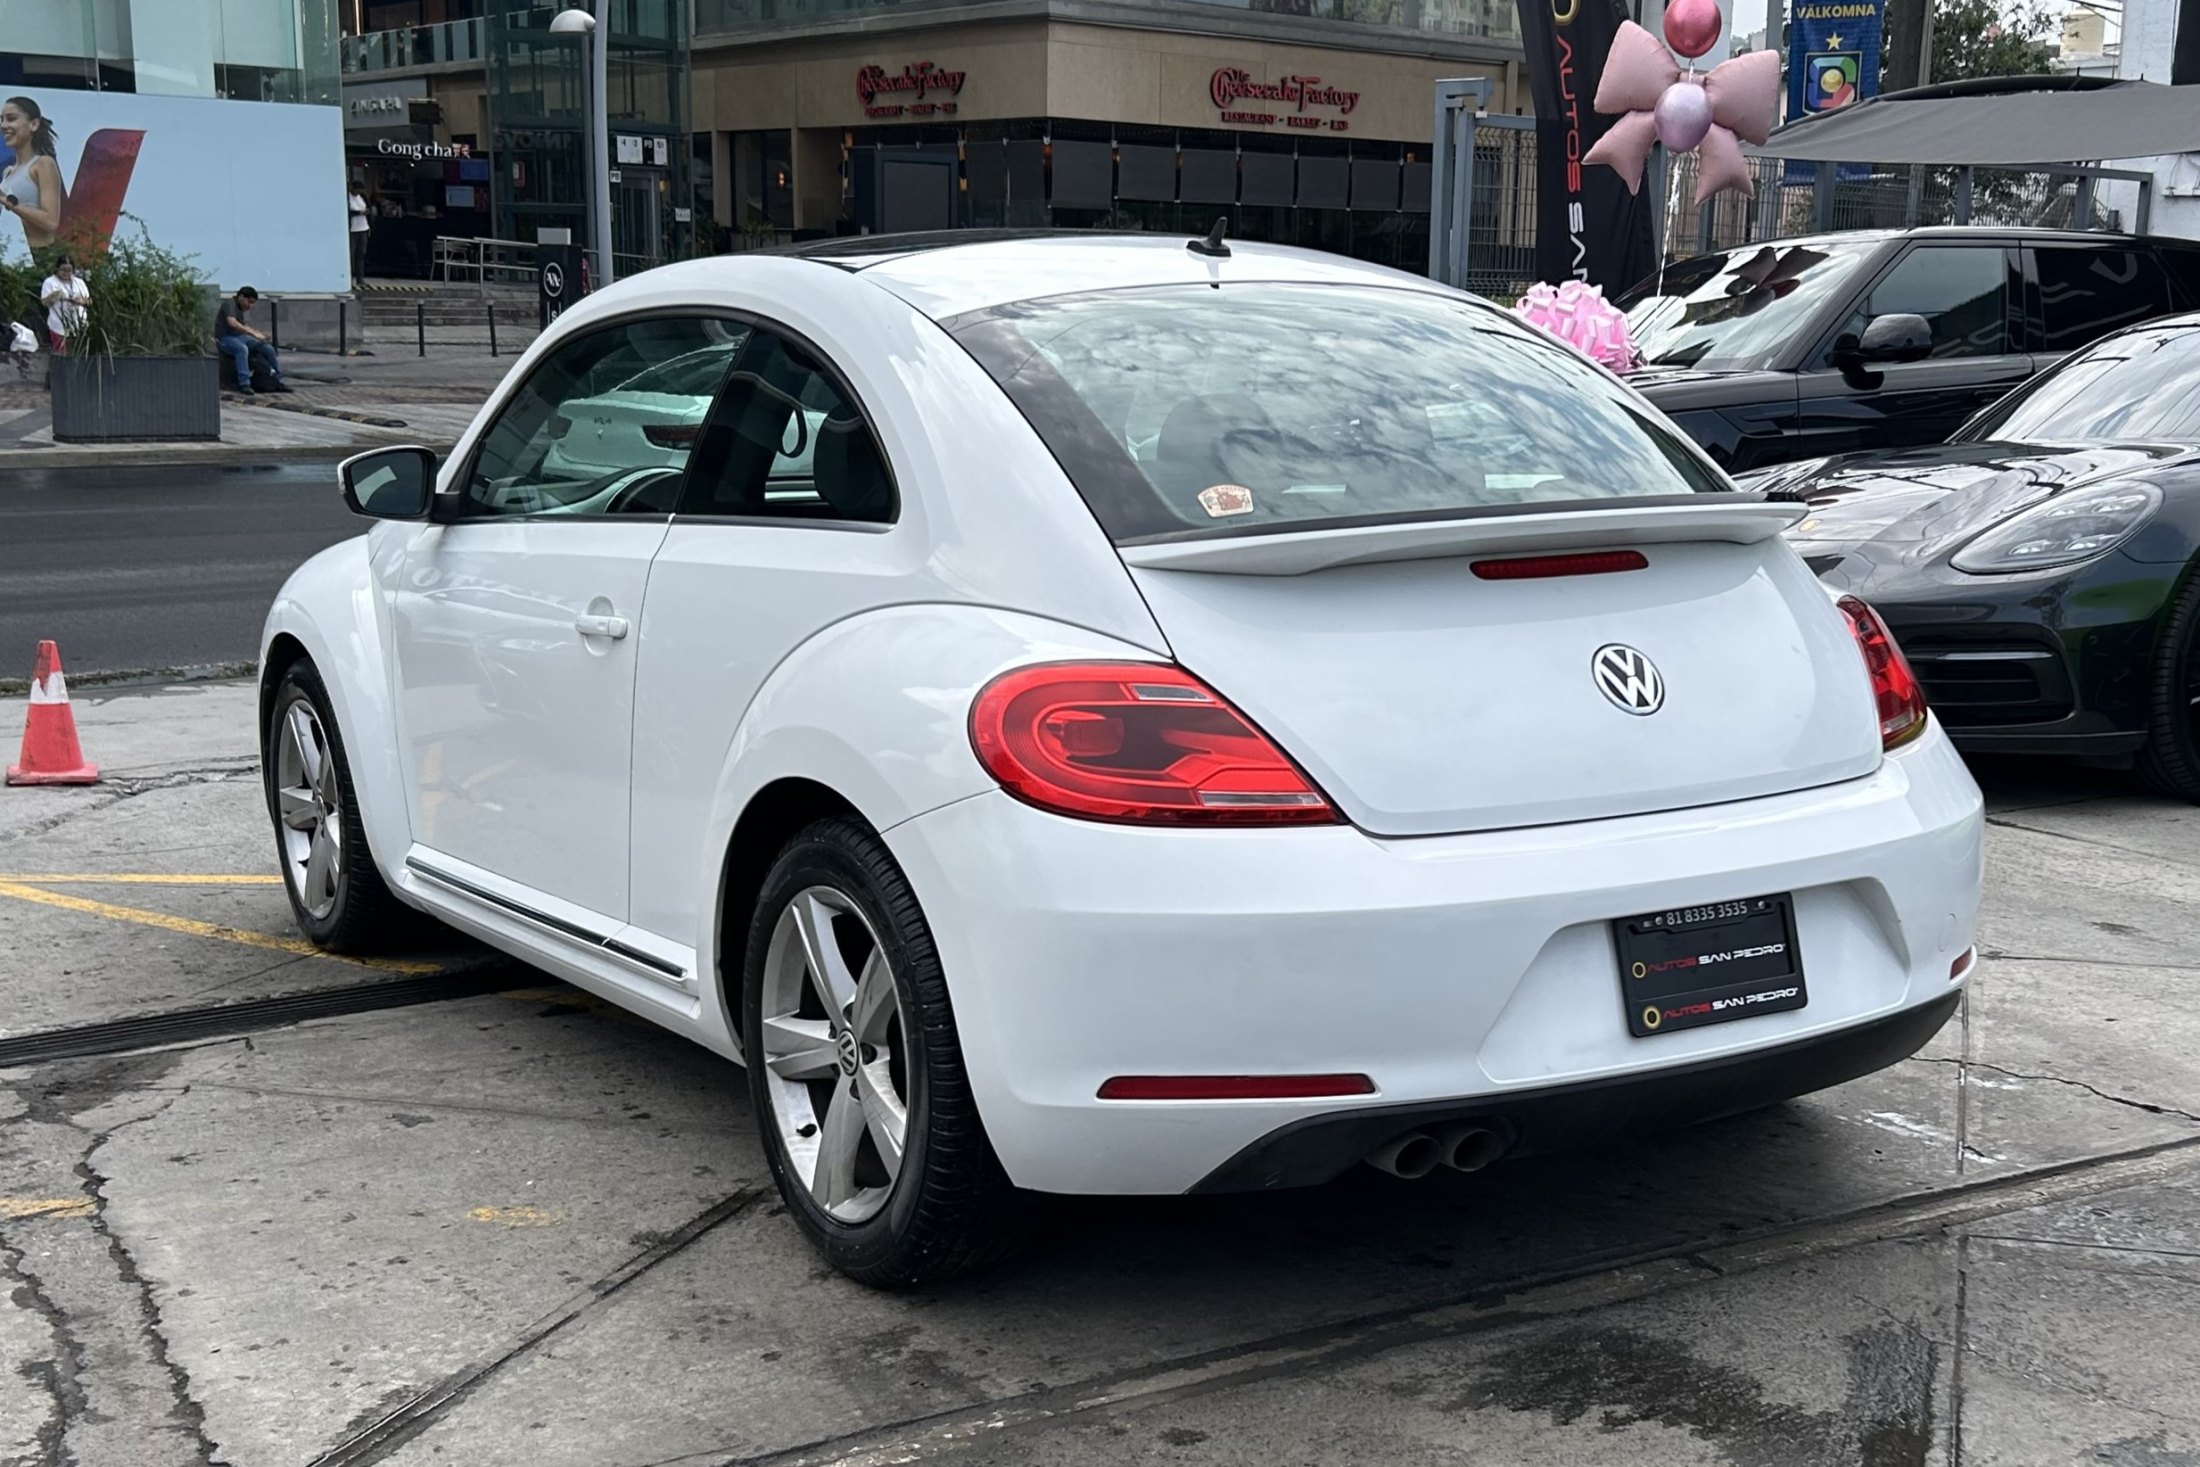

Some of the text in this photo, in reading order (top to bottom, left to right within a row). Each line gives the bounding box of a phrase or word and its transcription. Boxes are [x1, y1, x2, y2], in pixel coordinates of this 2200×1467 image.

[1796, 3, 1877, 19] VÄLKOMNA
[1210, 67, 1361, 115] Cheesecake Factory
[1556, 34, 1582, 194] AUTOS
[378, 138, 423, 160] Gong
[424, 141, 452, 158] cha
[1594, 645, 1662, 714] VW
[1666, 901, 1748, 926] 81 8335 3535
[1648, 943, 1785, 973] AUTOS SAN PEDRO
[1663, 987, 1798, 1019] AUTOS SAN PEDRO
